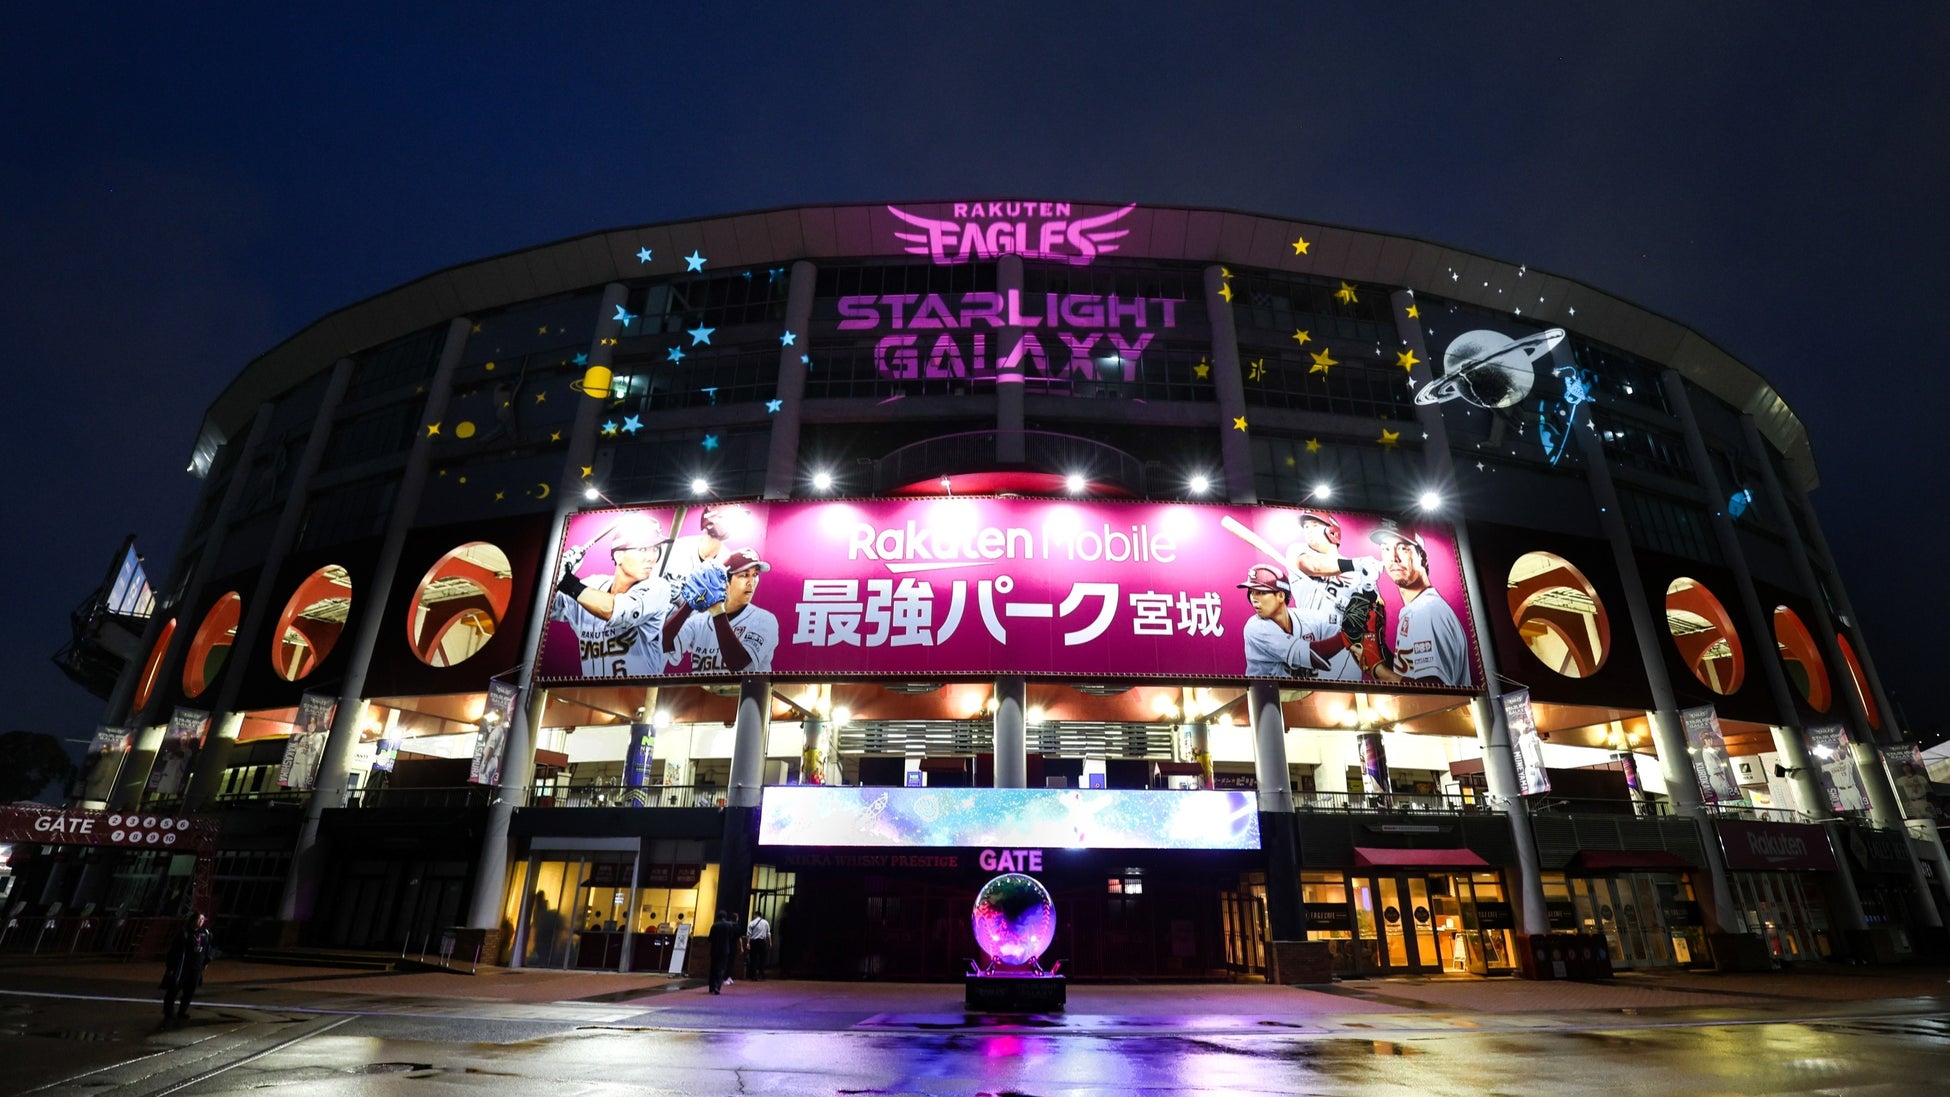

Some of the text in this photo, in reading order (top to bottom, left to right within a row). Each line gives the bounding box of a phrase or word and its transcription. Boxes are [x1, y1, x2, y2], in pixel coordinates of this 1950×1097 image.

[954, 203, 1071, 218] RAKUTEN
[910, 212, 1118, 265] EAGLES
[837, 289, 1186, 330] STARLIGHT
[874, 333, 1155, 382] GALAXY
[848, 520, 1176, 563] Rakuten Mobile
[793, 575, 1225, 647] 最強パーク 宮城
[581, 629, 616, 639] RAKUTEN
[34, 816, 95, 834] GATE
[1747, 831, 1808, 857] Rakuten
[834, 855, 888, 867] WHISKY
[890, 855, 959, 868] PRESTIGE
[979, 849, 1043, 872] GATE
